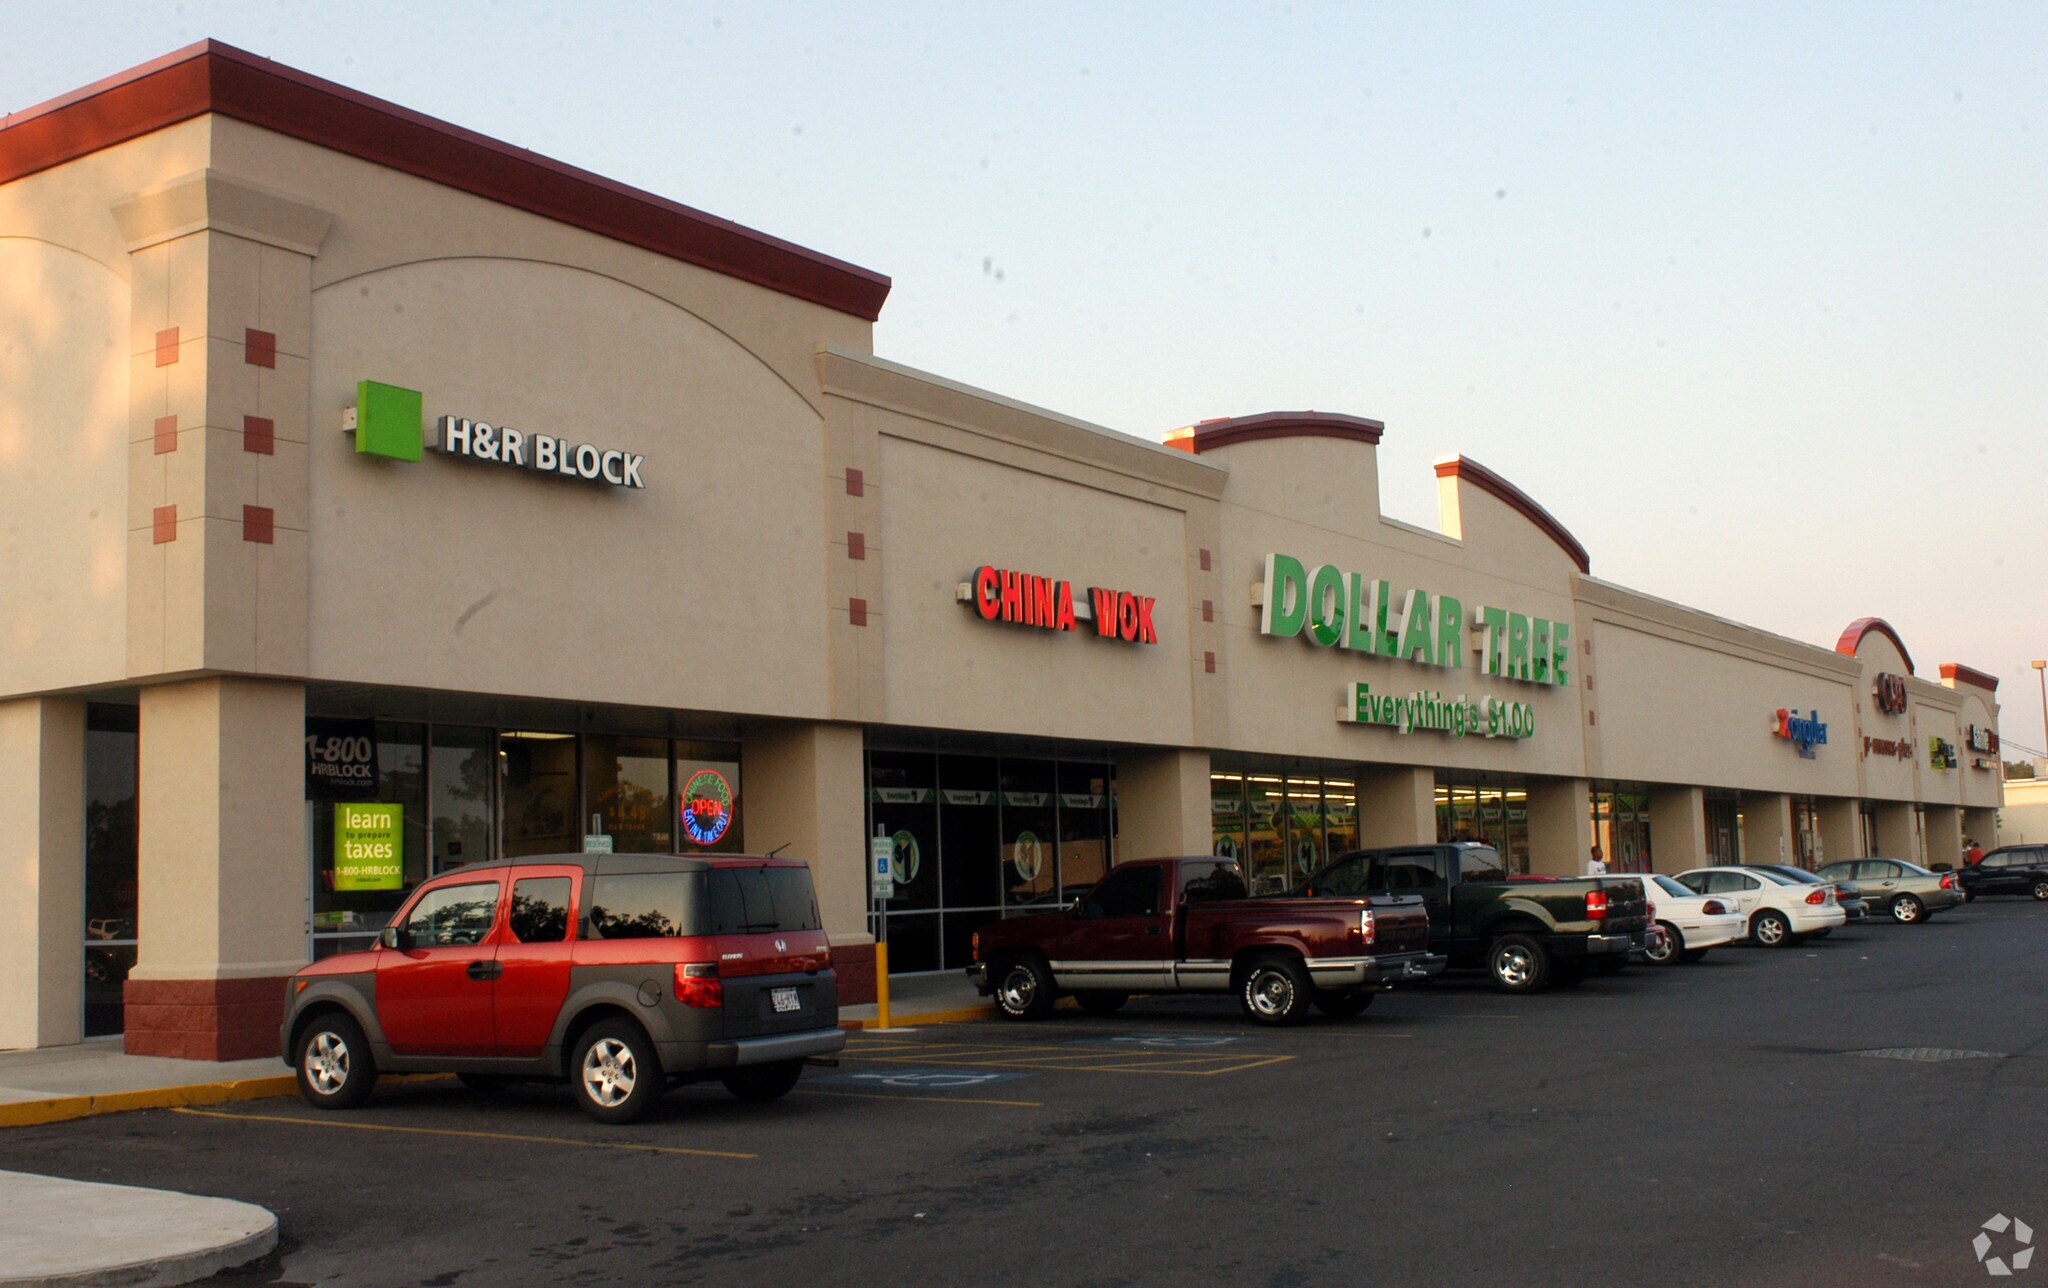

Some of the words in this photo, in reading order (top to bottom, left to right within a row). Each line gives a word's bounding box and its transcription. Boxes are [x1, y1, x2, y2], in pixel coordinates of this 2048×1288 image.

[439, 415, 524, 466] H&R
[529, 432, 646, 489] BLOCK
[971, 565, 1076, 632] CHINA
[1088, 587, 1157, 644] WOK
[1261, 553, 1463, 668] DOLLAR
[1476, 605, 1570, 686] TREE
[1348, 682, 1479, 738] Everything's
[1482, 696, 1535, 738] $1.00
[305, 734, 372, 762] 1-800
[312, 762, 371, 778] HRBLOCK
[346, 807, 391, 829] learn
[691, 798, 722, 816] OPEN
[358, 832, 391, 840] prepare
[344, 840, 393, 859] taxes
[336, 865, 401, 876] 1-800-HRBLOCK
